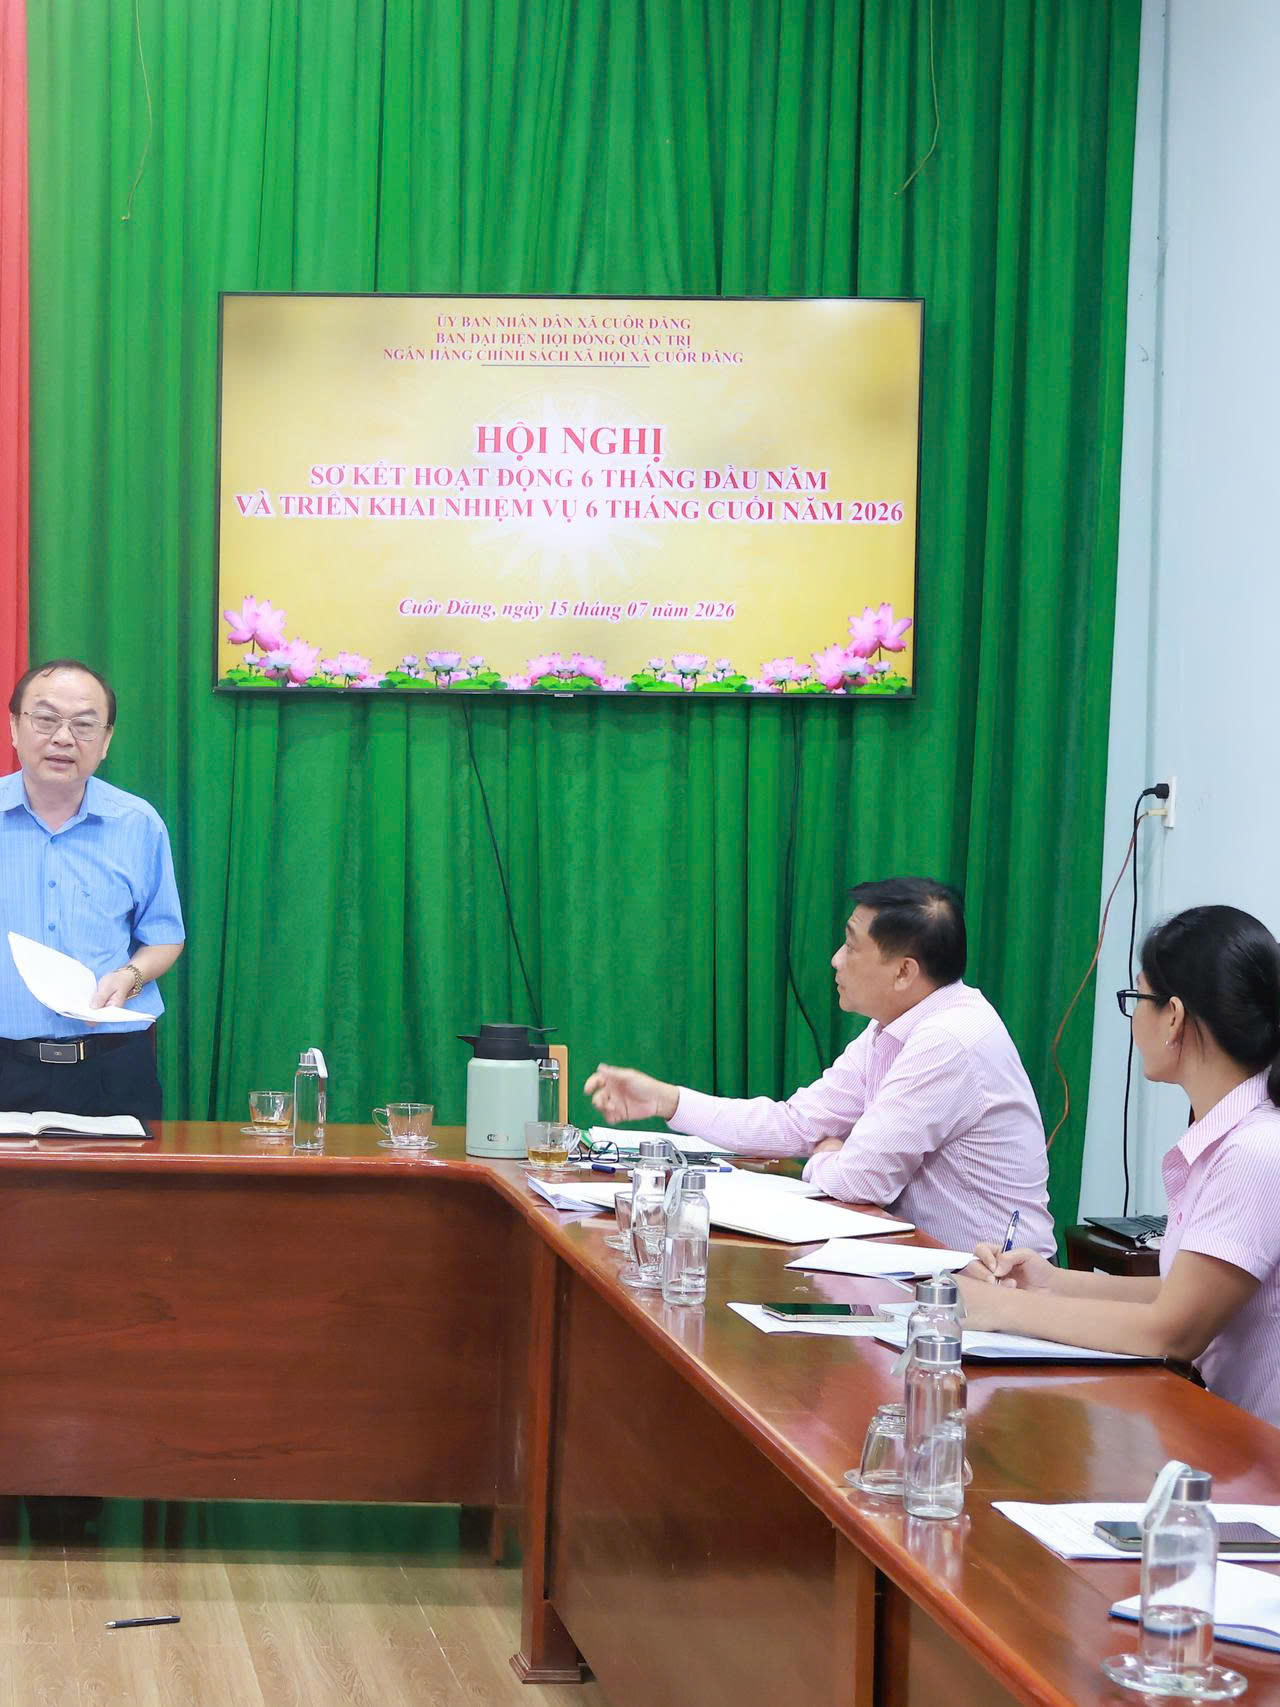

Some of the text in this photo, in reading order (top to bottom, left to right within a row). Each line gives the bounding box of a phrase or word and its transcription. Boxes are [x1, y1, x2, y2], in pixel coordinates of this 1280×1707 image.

[462, 316, 491, 328] BAN
[496, 313, 538, 328] NHÂN
[543, 313, 573, 328] DÂN
[578, 315, 598, 329] XÃ
[602, 314, 645, 329] CUÔR
[436, 332, 466, 344] BAN
[541, 331, 568, 348] HỘI
[666, 334, 691, 349] TRỊ
[383, 345, 426, 361] NGÂN
[430, 346, 472, 361] HÀNG
[476, 347, 526, 361] CHÍNH
[529, 347, 569, 362] SÁCH
[573, 348, 594, 362] XÃ
[598, 348, 625, 365] HỘI
[630, 349, 651, 363] XÃ
[654, 348, 697, 363] CUÔR
[477, 421, 665, 463] HỘI NGHỊ
[310, 460, 827, 492] SƠ KẾT HOẠT ĐỘNG 6 THÁNG ĐẦU NĂM
[235, 489, 904, 524] VÀ TRIỂN KHAI NHIỆM VỤ 6 THÁNG CUỐI NĂM 2026
[399, 599, 736, 621] Cuôr Đăng, ngày 15 tháng 07 năm 2026
